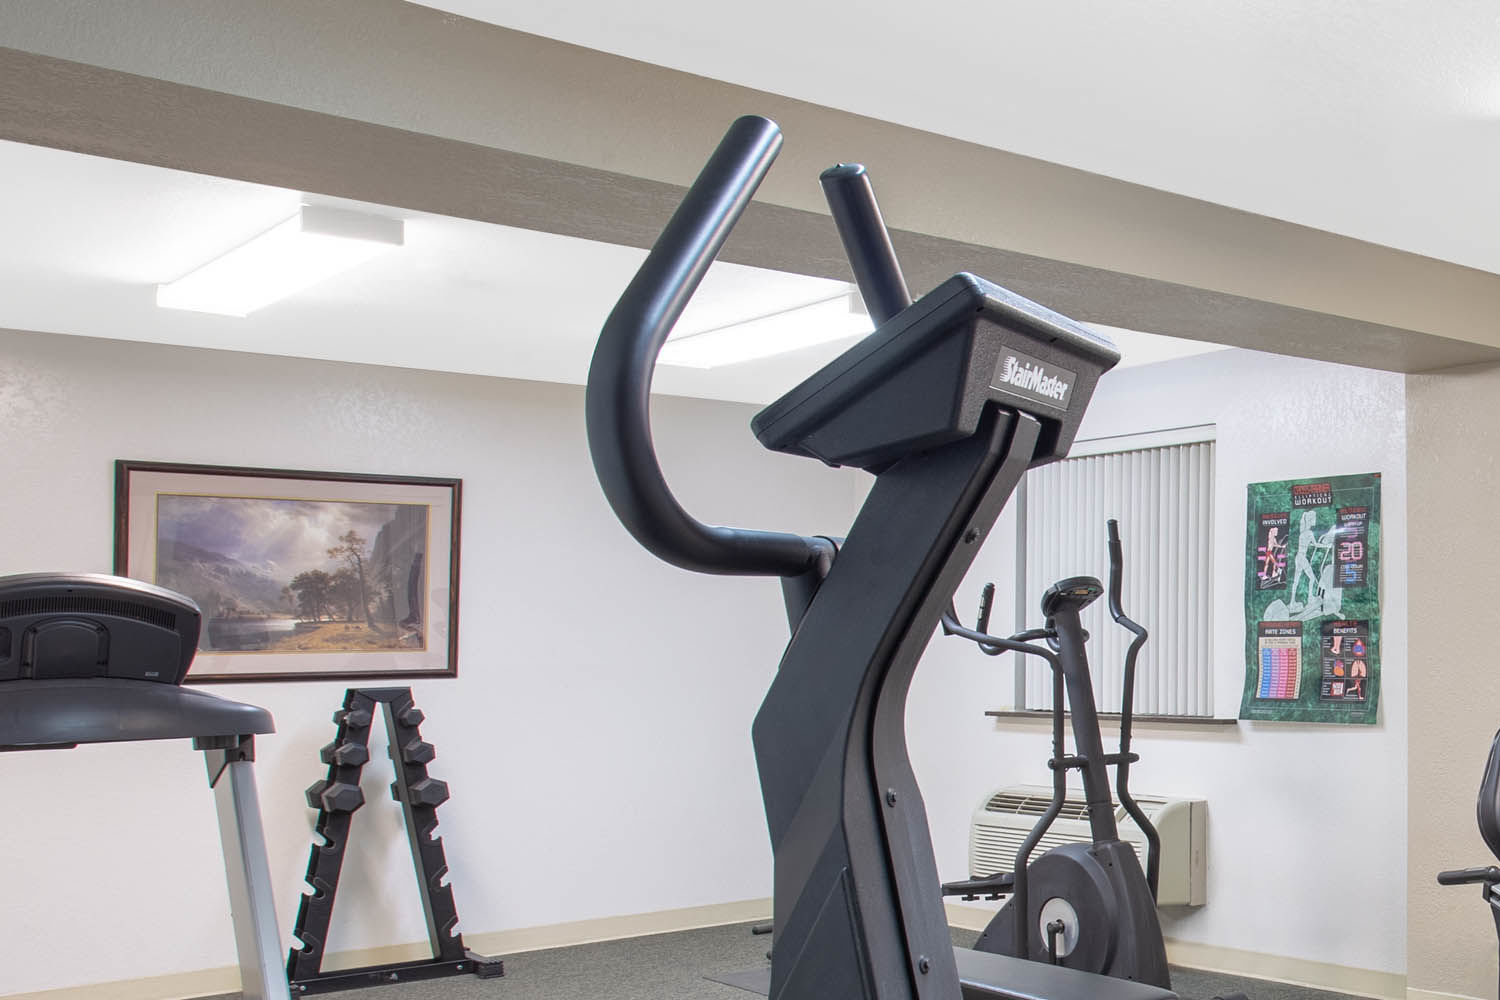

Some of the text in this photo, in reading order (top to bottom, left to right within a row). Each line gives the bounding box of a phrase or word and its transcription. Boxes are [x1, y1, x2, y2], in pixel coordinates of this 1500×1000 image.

[1000, 355, 1068, 400] StairMaster
[1294, 496, 1332, 506] WORKOUT
[1262, 518, 1288, 526] INVOLVED
[1340, 541, 1363, 560] 20
